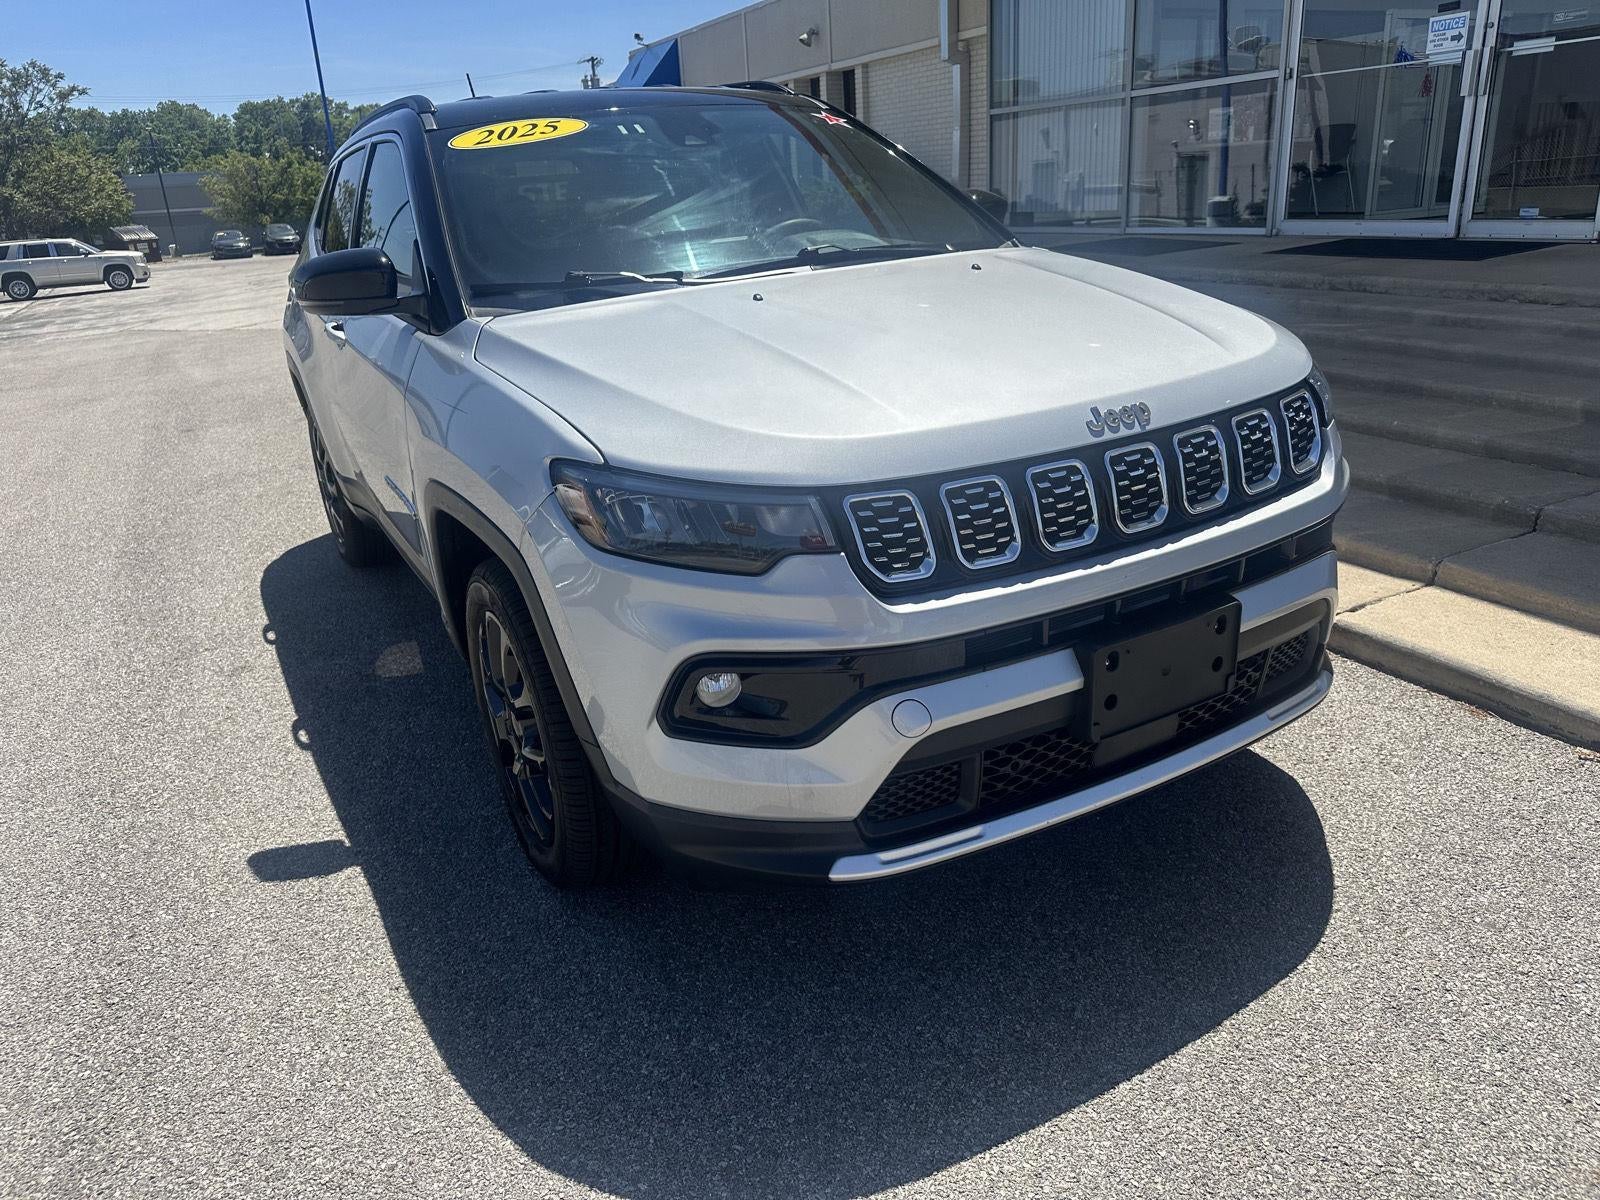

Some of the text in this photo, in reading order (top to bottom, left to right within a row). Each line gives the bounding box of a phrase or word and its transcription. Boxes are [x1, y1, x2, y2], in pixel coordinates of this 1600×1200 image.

[1432, 18, 1465, 31] NOTICE
[473, 120, 561, 145] 2025
[1086, 402, 1151, 438] Jeep
